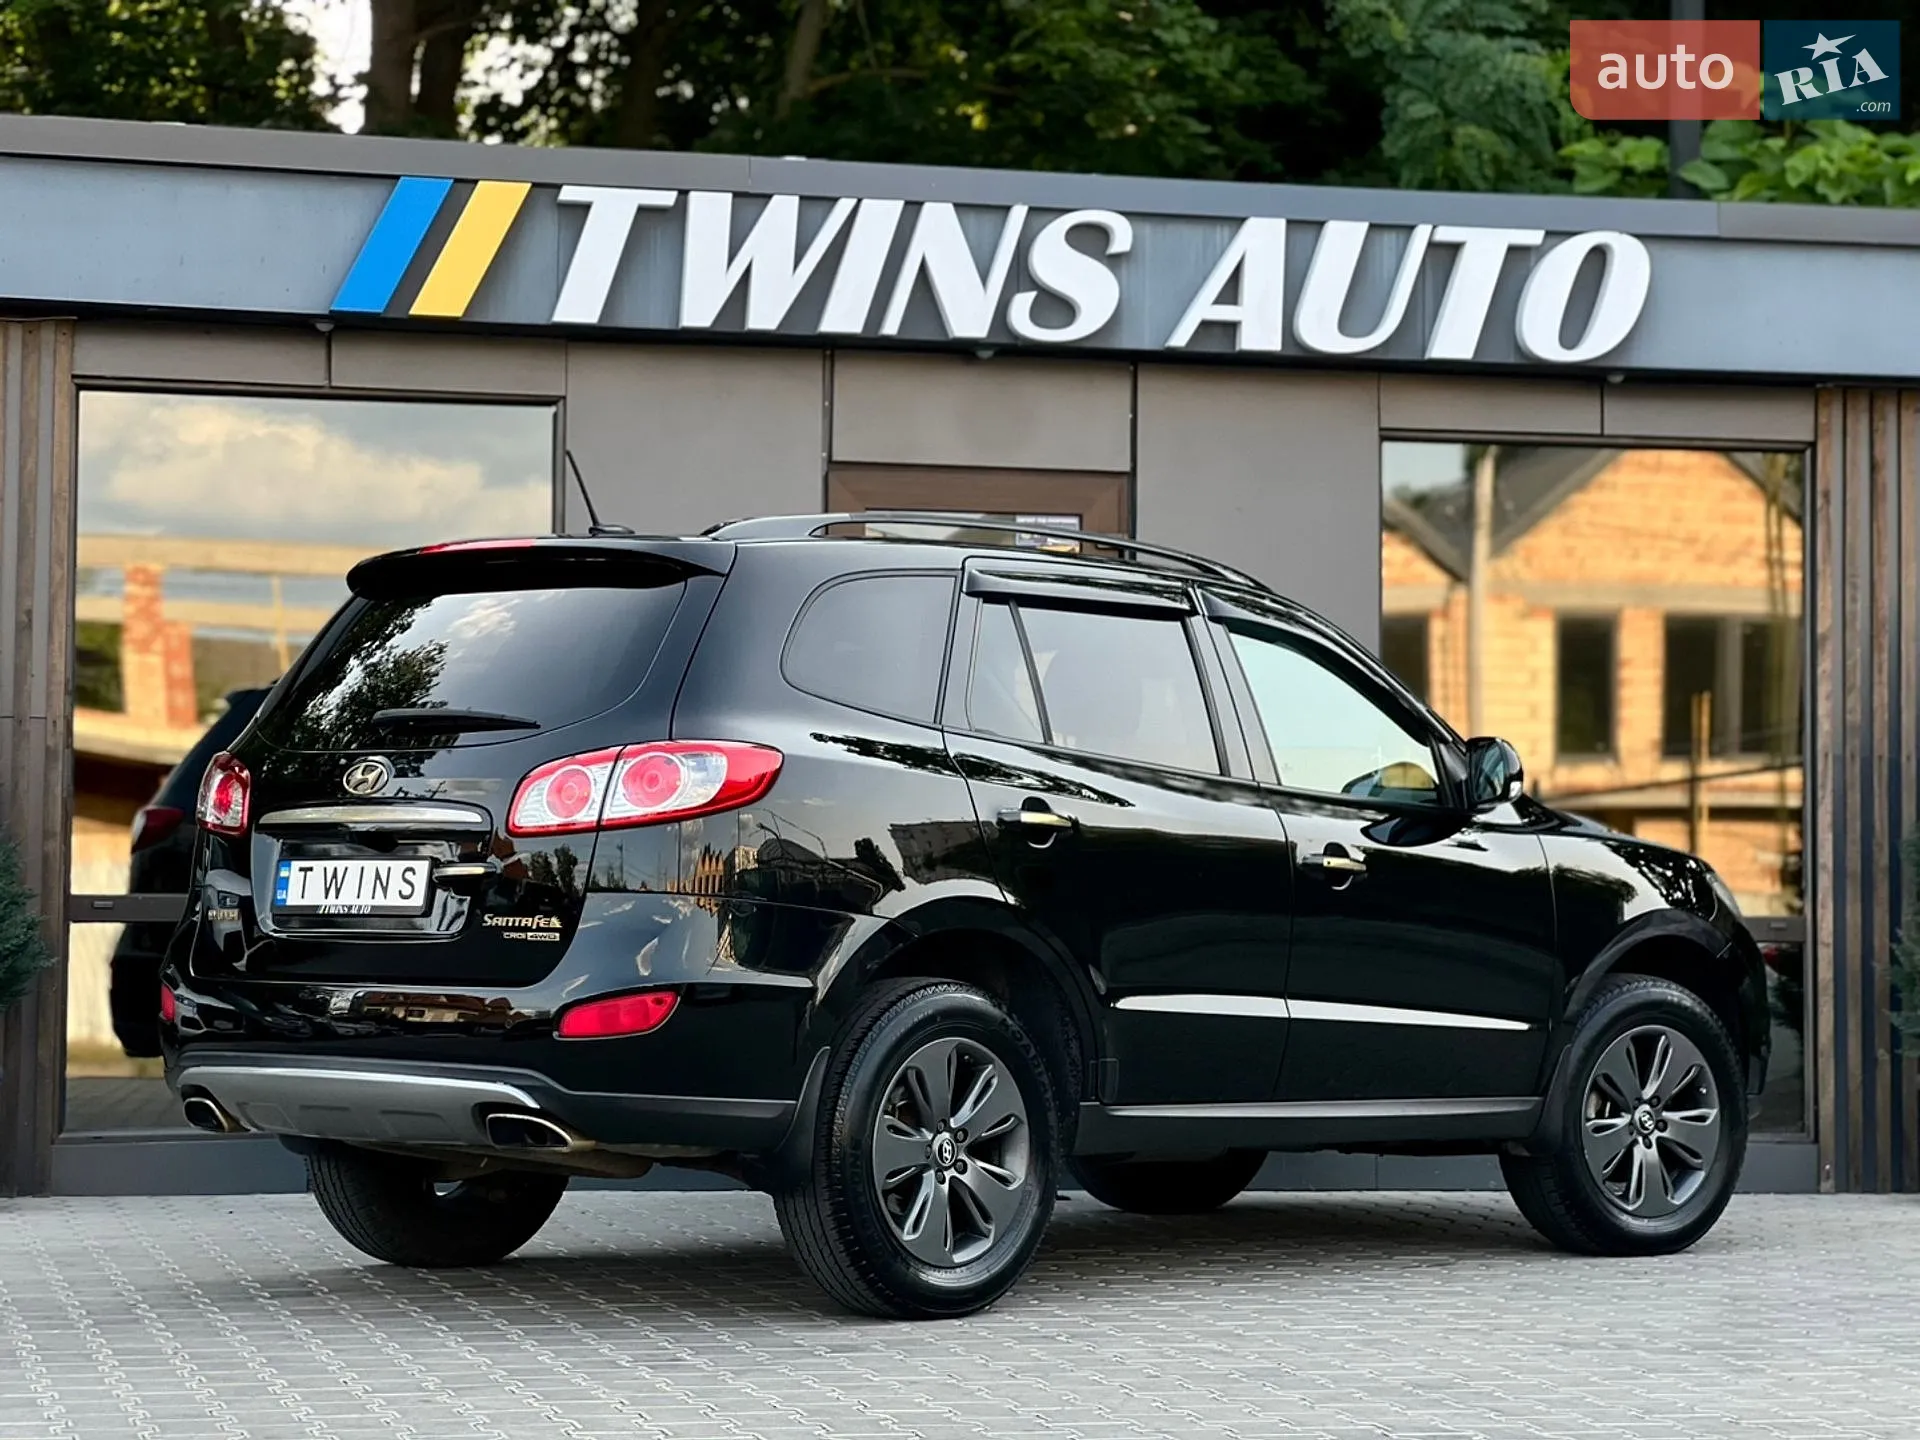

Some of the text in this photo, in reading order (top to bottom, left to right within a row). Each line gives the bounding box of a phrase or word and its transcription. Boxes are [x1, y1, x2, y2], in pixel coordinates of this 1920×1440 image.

[551, 185, 1652, 363] TWINS AUTO
[298, 866, 417, 900] TWINS
